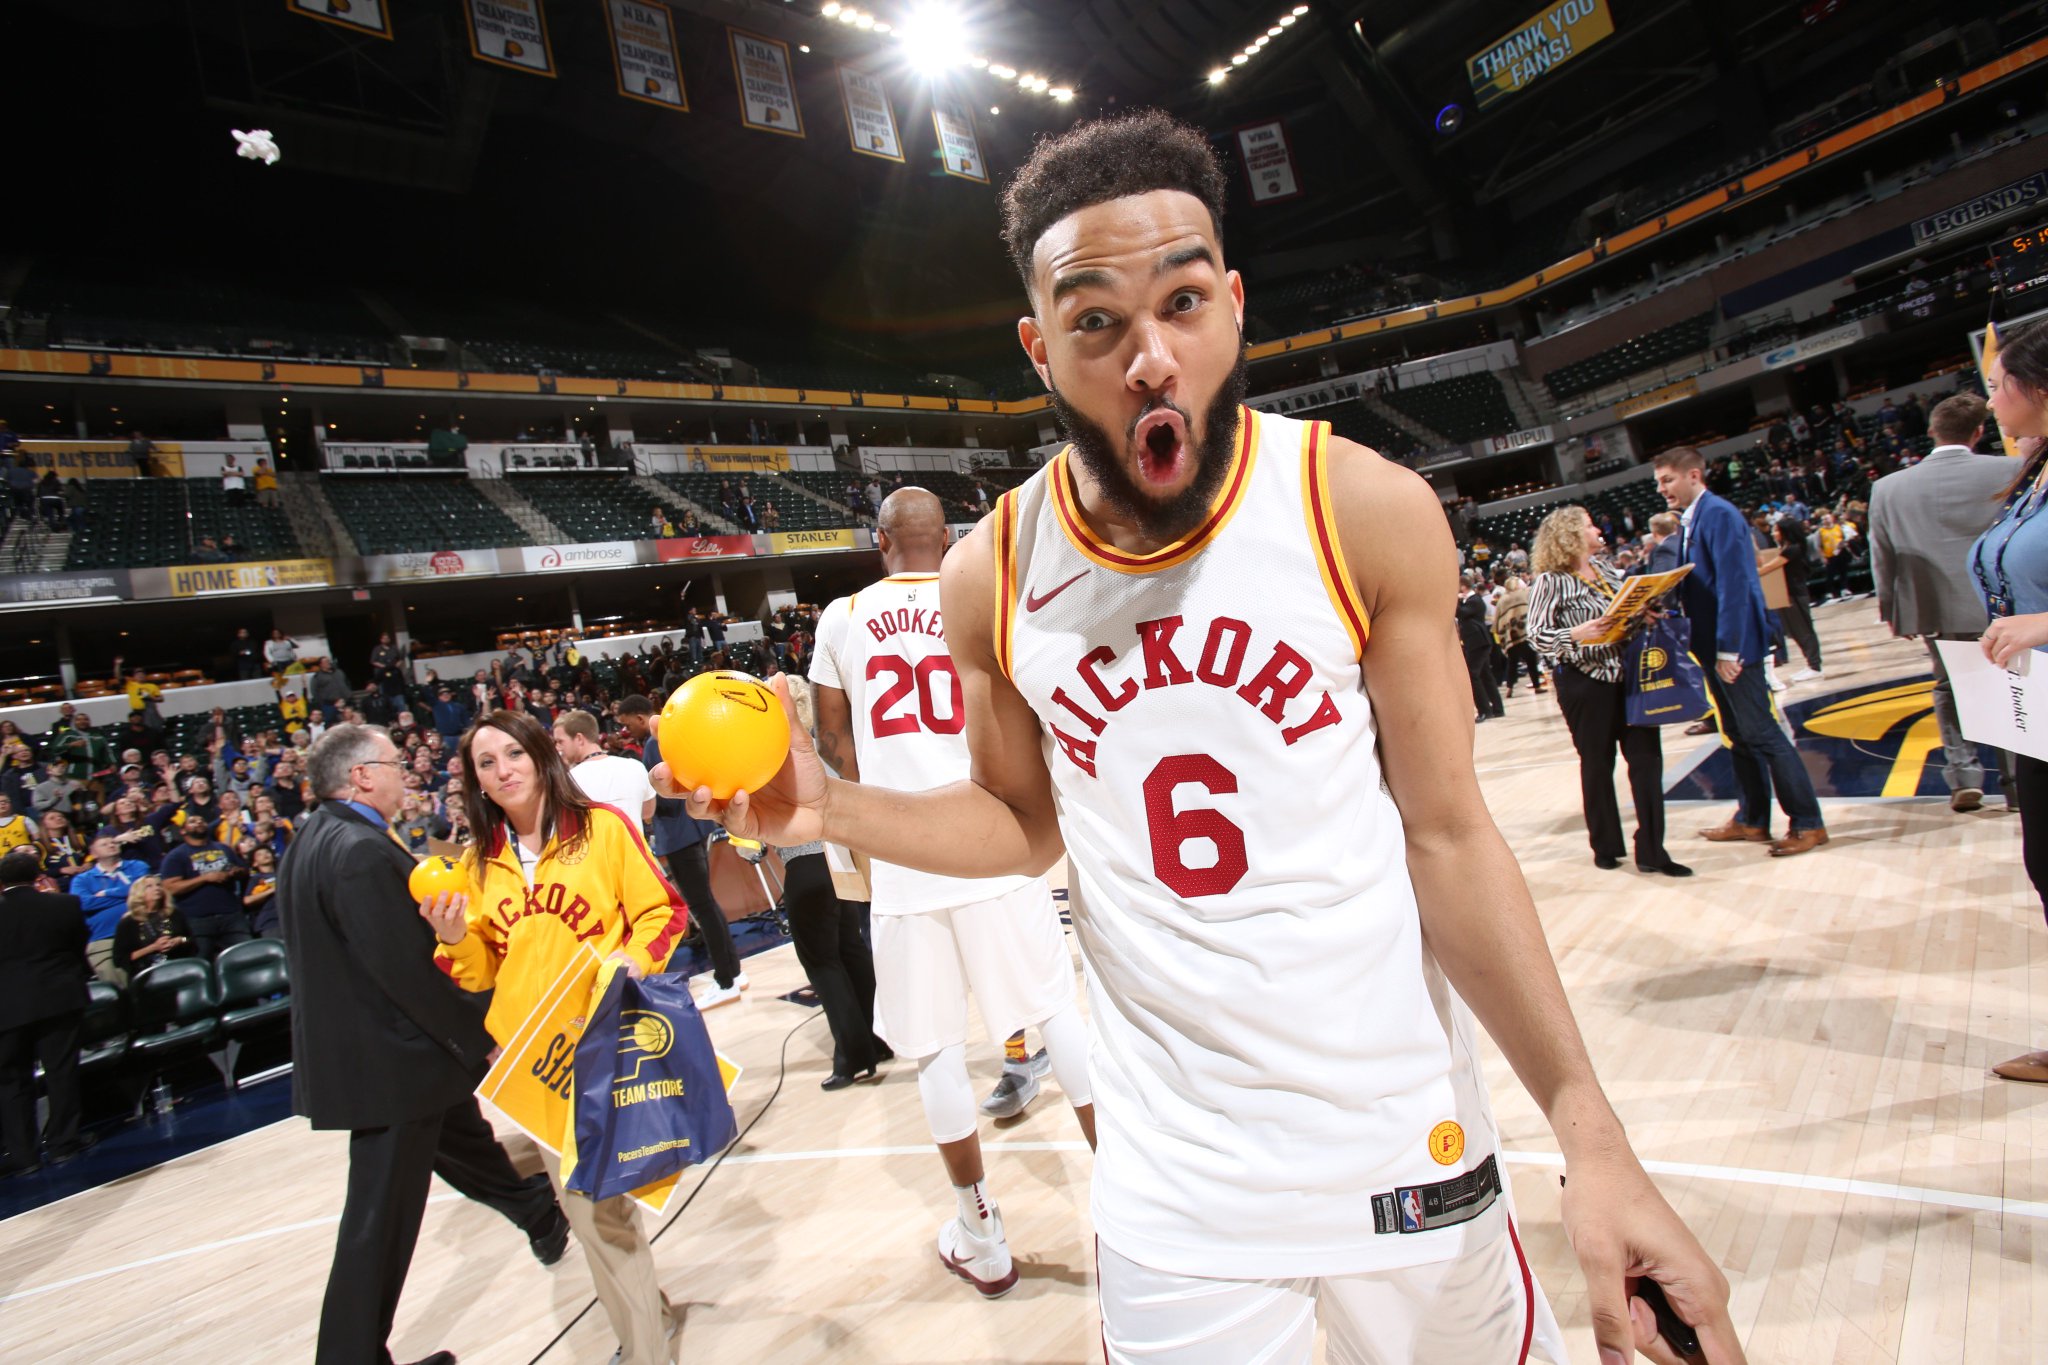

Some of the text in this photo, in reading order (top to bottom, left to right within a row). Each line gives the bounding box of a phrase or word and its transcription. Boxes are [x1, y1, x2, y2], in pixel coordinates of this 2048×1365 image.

[622, 5, 656, 27] NBA
[744, 42, 776, 62] NBA
[1477, 0, 1597, 79] THANK YOU
[1510, 32, 1573, 87] FANS!
[1919, 179, 2039, 240] LEGENDS
[1510, 428, 1547, 448] IUPUI
[691, 539, 723, 556] Lilly
[786, 531, 839, 544] STANLEY
[564, 547, 622, 561] ambrose
[177, 567, 264, 593] HOME OF
[752, 625, 758, 635] 5
[866, 655, 966, 739] 20
[1049, 614, 1343, 779] HICKORY
[2009, 685, 2029, 733] Booker
[1143, 753, 1249, 899] 6
[612, 1078, 685, 1108] TEAM STORE
[618, 1138, 691, 1163] PacersTeamStore.com
[1428, 1197, 1439, 1206] 48
